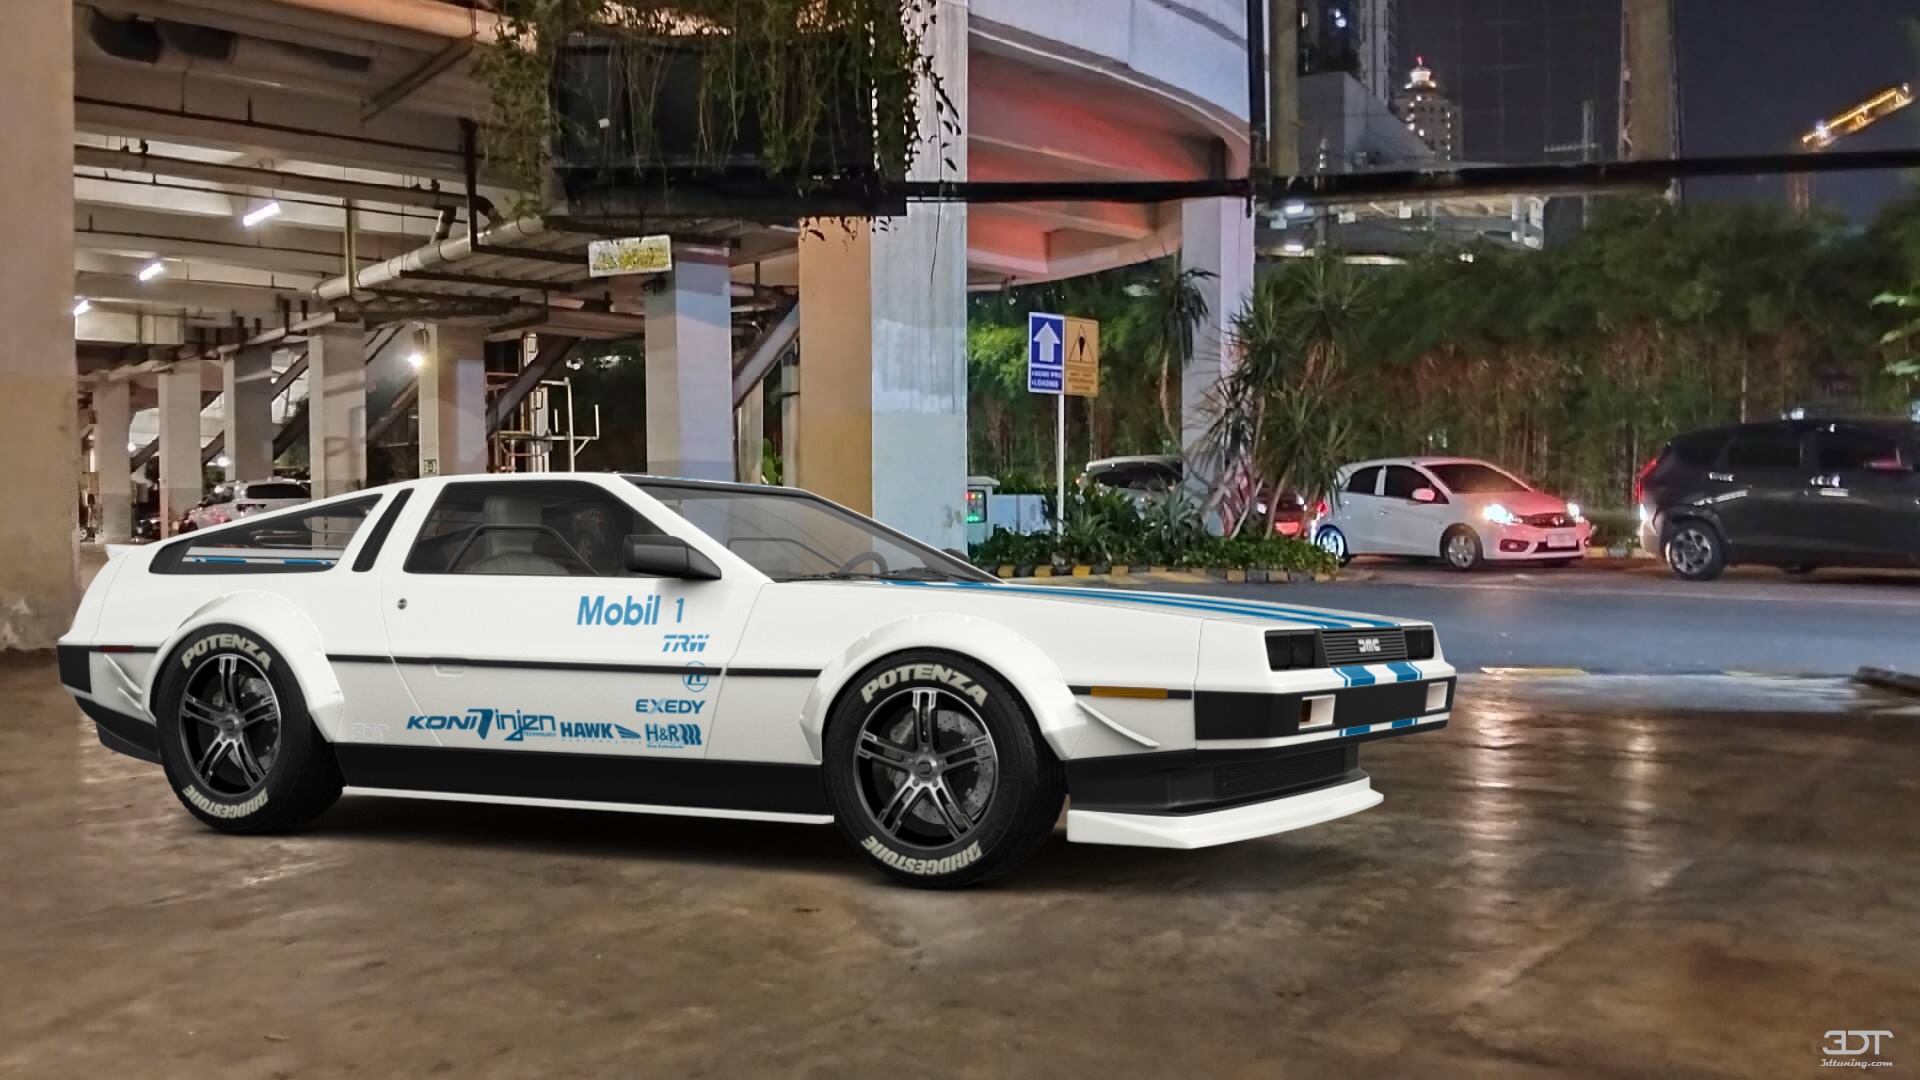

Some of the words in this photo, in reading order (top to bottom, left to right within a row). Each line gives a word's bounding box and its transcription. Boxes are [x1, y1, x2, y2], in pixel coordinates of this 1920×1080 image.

[577, 595, 661, 626] Mobil
[676, 597, 685, 623] 1
[181, 633, 271, 672] POTENZA
[662, 634, 709, 652] TRW
[861, 664, 988, 707] POTENZA
[635, 699, 705, 714] EXEDY
[406, 715, 477, 730] KONI
[494, 709, 556, 741] injen
[560, 722, 614, 739] HAWK
[645, 723, 680, 741] H&R
[182, 784, 269, 819] BRIDGESTONE
[861, 835, 982, 875] BRIDGESTONE
